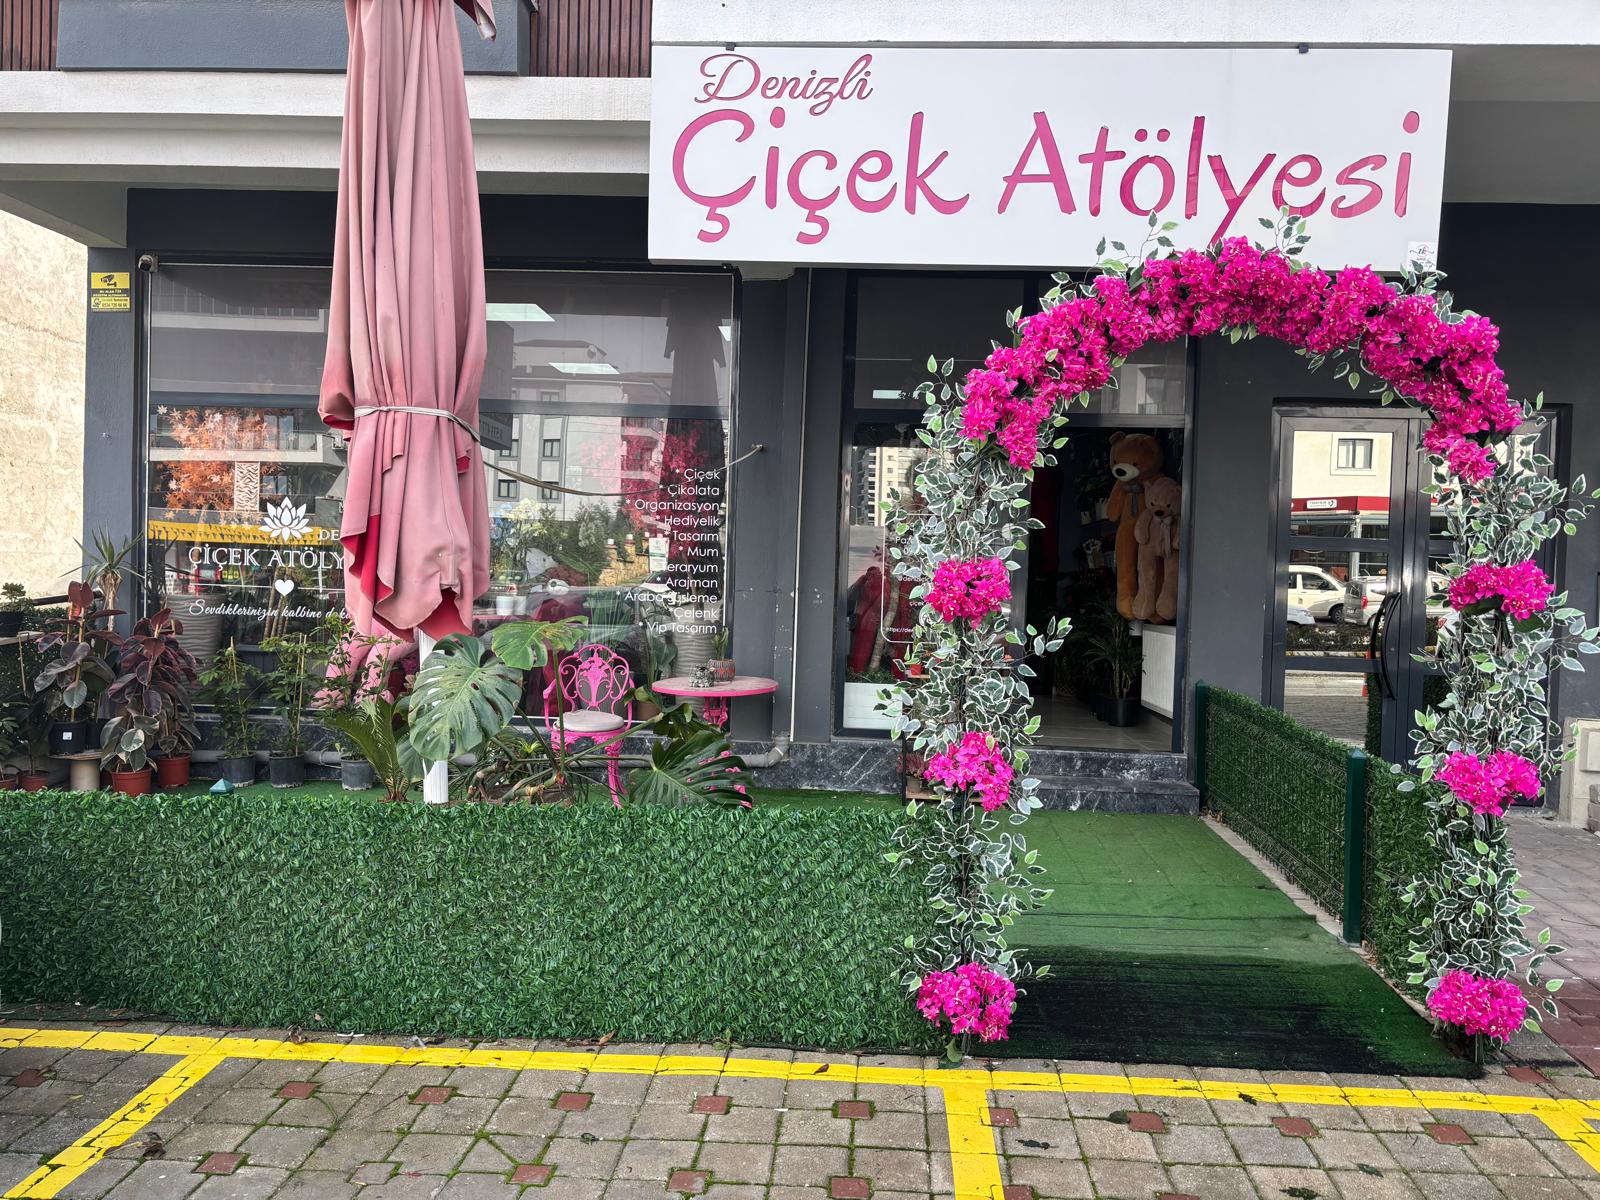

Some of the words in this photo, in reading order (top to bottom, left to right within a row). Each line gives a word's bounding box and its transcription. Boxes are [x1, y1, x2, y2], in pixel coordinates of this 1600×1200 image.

[694, 53, 873, 116] Denizli
[672, 106, 969, 245] Çiçek
[998, 110, 1420, 247] Atölyesi
[683, 468, 720, 482] Çiçek
[667, 484, 720, 497] Çikolata
[634, 499, 720, 512] Organizasyon
[664, 515, 720, 528] Hediyelik
[672, 530, 719, 541] Tasarım
[188, 543, 260, 571] ÇİÇEK
[687, 546, 719, 557] Mum
[665, 577, 718, 589] Arajman
[624, 591, 663, 602] Araba
[189, 599, 278, 621] Sevdiklerinizin
[281, 605, 322, 618] kalbine
[673, 607, 718, 619] Çelenk
[646, 622, 667, 634] Vip
[671, 622, 717, 634] Tasarım
